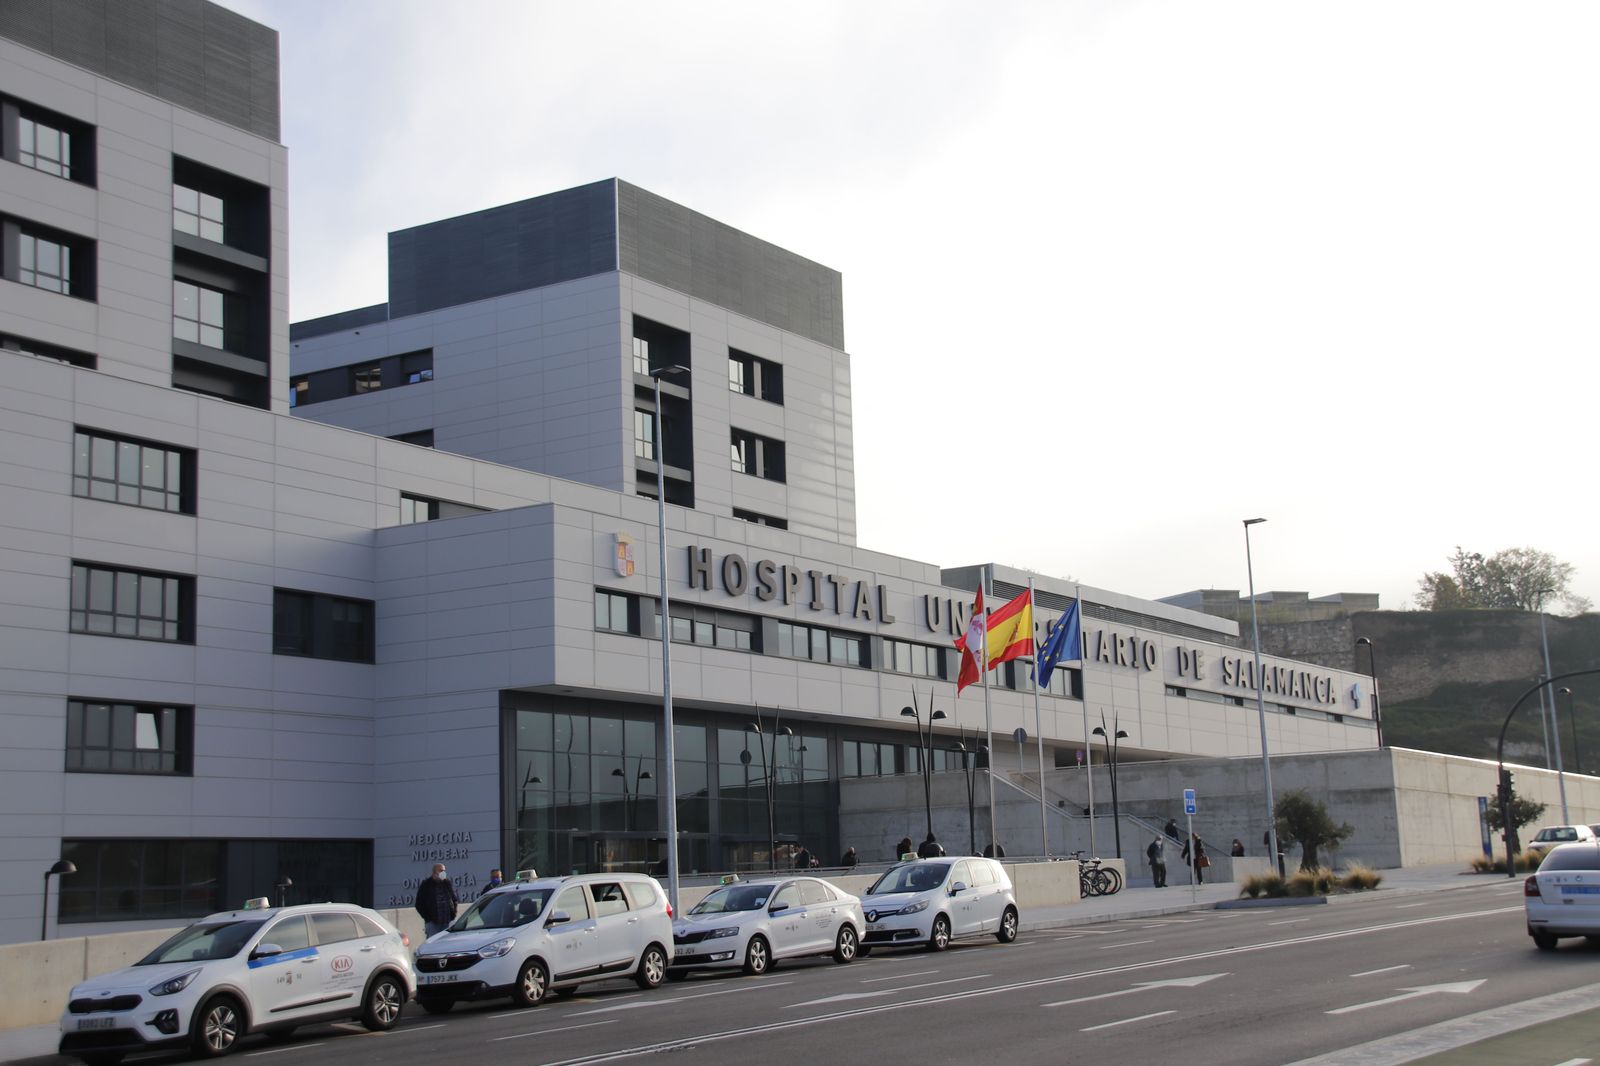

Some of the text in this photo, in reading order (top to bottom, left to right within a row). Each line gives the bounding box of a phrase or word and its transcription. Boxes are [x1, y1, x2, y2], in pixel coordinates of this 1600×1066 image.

[687, 545, 896, 624] HOSPITAL
[1176, 645, 1205, 680] DE
[1222, 655, 1336, 704] SALAMANCA
[408, 831, 473, 846] MEDICINA
[411, 847, 470, 862] NUCLEAR
[335, 958, 350, 969] KIA
